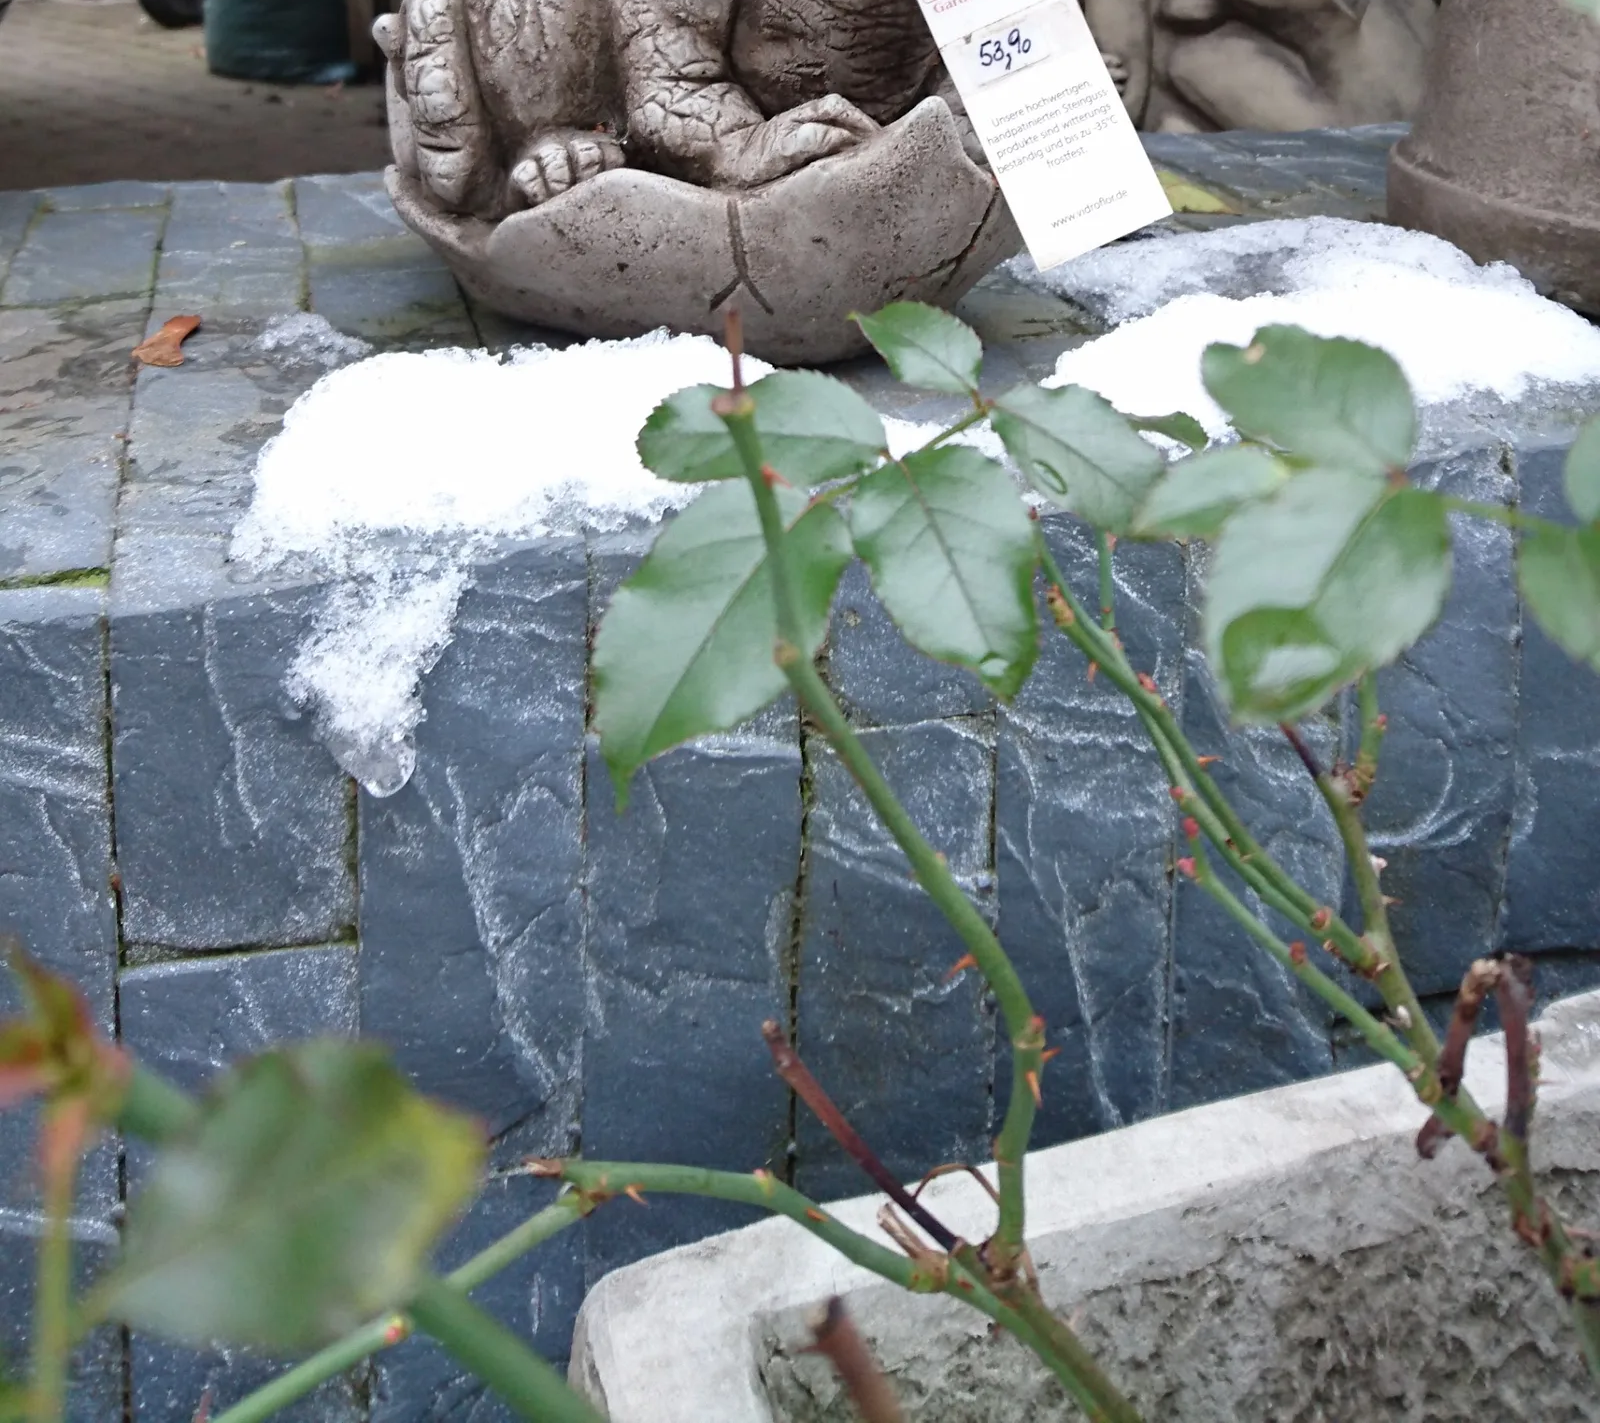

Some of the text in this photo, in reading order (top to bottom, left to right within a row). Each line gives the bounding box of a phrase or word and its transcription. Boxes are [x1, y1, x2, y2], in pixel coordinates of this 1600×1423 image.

[980, 28, 1031, 70] 53,90
[986, 108, 1062, 146] handpatinierten
[991, 109, 1025, 127] Unsere
[996, 134, 1039, 160] produkte
[1040, 124, 1060, 139] sind
[1044, 138, 1064, 153] und
[1063, 132, 1079, 145] bis
[1080, 127, 1092, 138] zu
[1046, 146, 1088, 168] frostfest.
[1050, 189, 1128, 228] www.vidroflor.de
